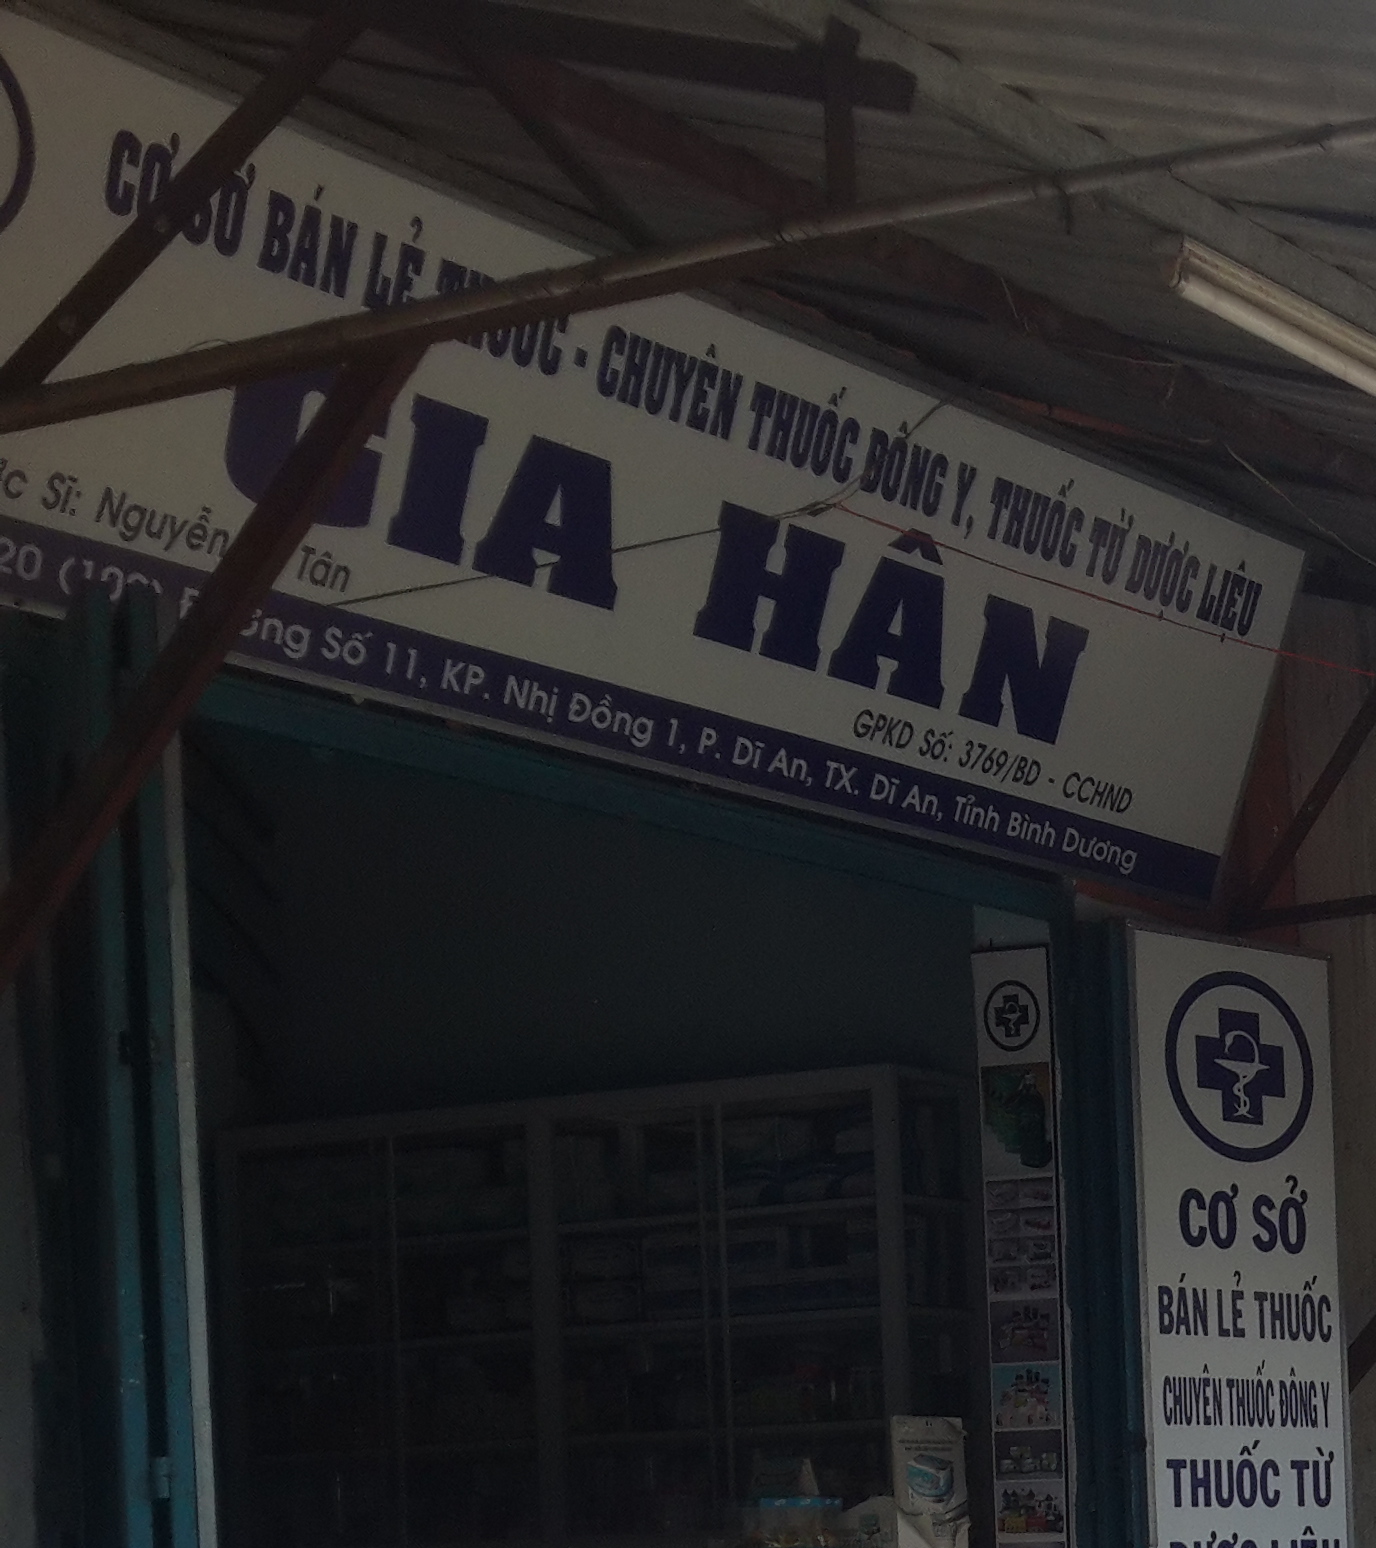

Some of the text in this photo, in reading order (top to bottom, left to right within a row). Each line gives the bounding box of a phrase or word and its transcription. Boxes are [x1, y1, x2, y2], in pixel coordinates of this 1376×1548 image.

[257, 185, 357, 299] BÁN
[595, 325, 744, 441] CHUYÊN
[748, 383, 862, 485] THUỐC
[987, 477, 1085, 569] THUỐC
[95, 485, 354, 594] Nguyễn Tân
[225, 370, 1090, 747] GIA HÂN
[320, 627, 374, 667] Số
[439, 657, 490, 702] KP.
[502, 674, 561, 723] Nhị
[567, 692, 656, 748] Đồng
[731, 734, 766, 770] Dĩ
[868, 772, 901, 806] Dĩ
[952, 793, 1001, 833] Tỉnh
[1005, 812, 1057, 849] Bình
[1061, 827, 1139, 877] Dương
[851, 708, 915, 750] GPKD
[957, 740, 1042, 789] 3769/BD
[1061, 771, 1134, 815] CCHND
[1178, 1174, 1309, 1255] CƠ SỞ
[1157, 1270, 1333, 1344] BÁN LẺ THUỐC
[1162, 1359, 1330, 1429] CHUYÊN THUỐC Y
[1166, 1439, 1336, 1509] THUỐC TỪ
